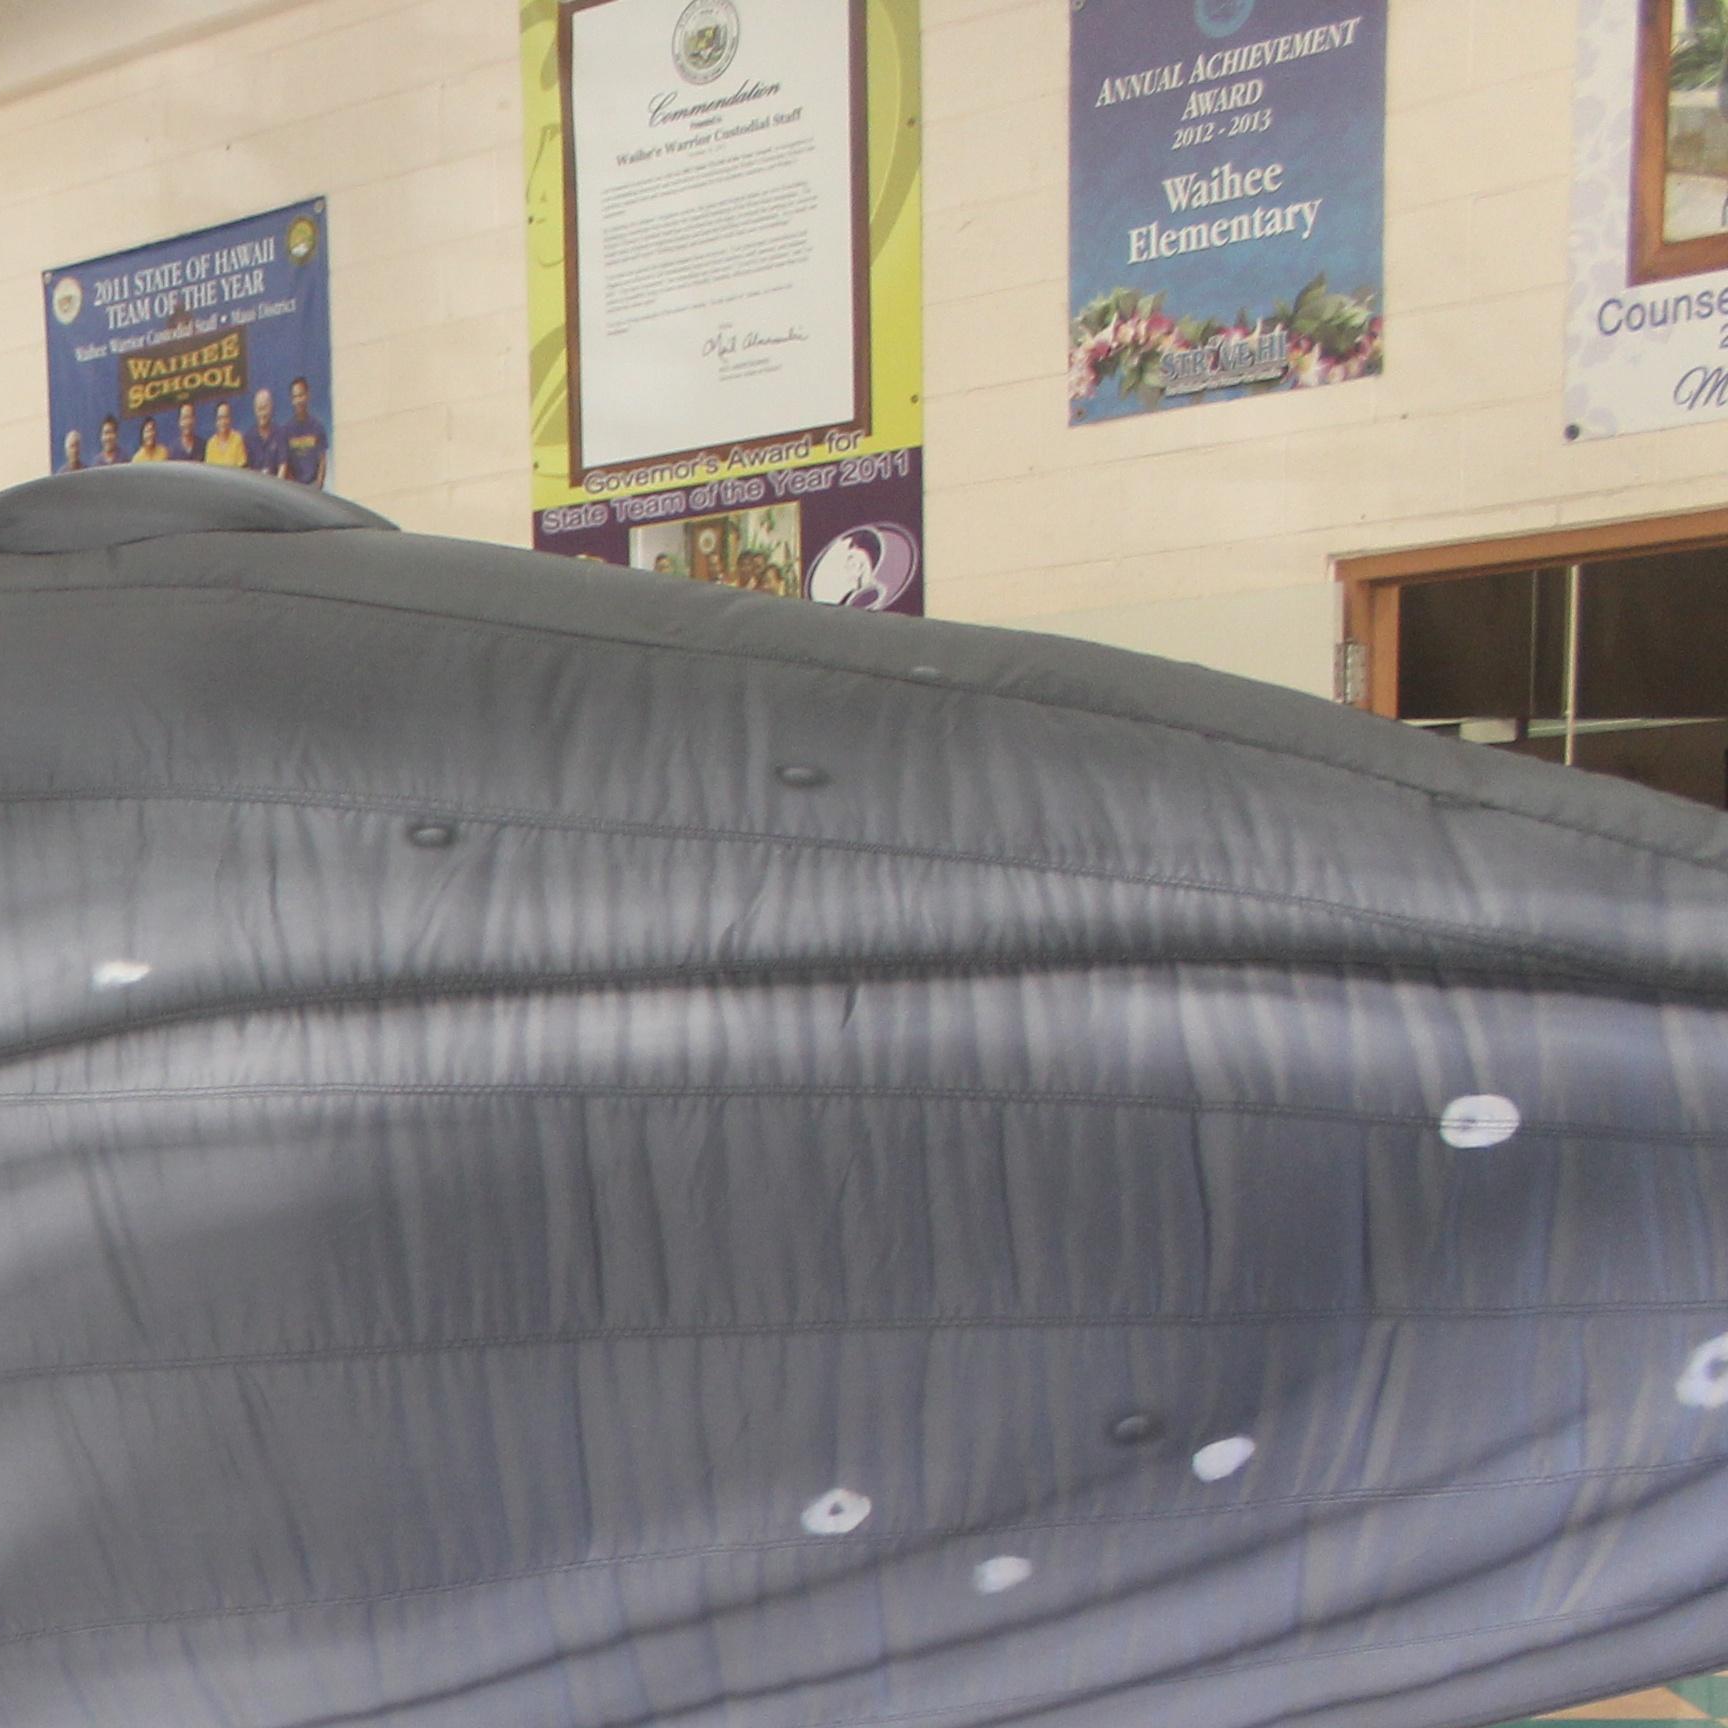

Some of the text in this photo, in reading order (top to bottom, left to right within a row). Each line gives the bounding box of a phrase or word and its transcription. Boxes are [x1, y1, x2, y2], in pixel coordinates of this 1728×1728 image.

[1095, 16, 1363, 109] ANNUAL ACHIEVEMENT
[649, 79, 781, 128] Commendation
[1181, 79, 1264, 121] AWARD
[664, 132, 712, 153] Warrior
[714, 116, 770, 142] Custodial
[773, 106, 804, 126] Staff
[1171, 122, 1216, 151] 2012
[1228, 108, 1273, 138] 2013
[1162, 162, 1284, 214] Waihee
[1127, 199, 1323, 265] Elementary
[93, 236, 276, 307] 2011 STATE OF HAWAII
[106, 269, 265, 330] TEAM OF THE YEAR
[128, 333, 240, 380] WAIHEE
[128, 364, 240, 410] SCHOOL
[584, 428, 865, 496] Governor's Award for
[541, 449, 911, 535] State Team of the Year 2011
